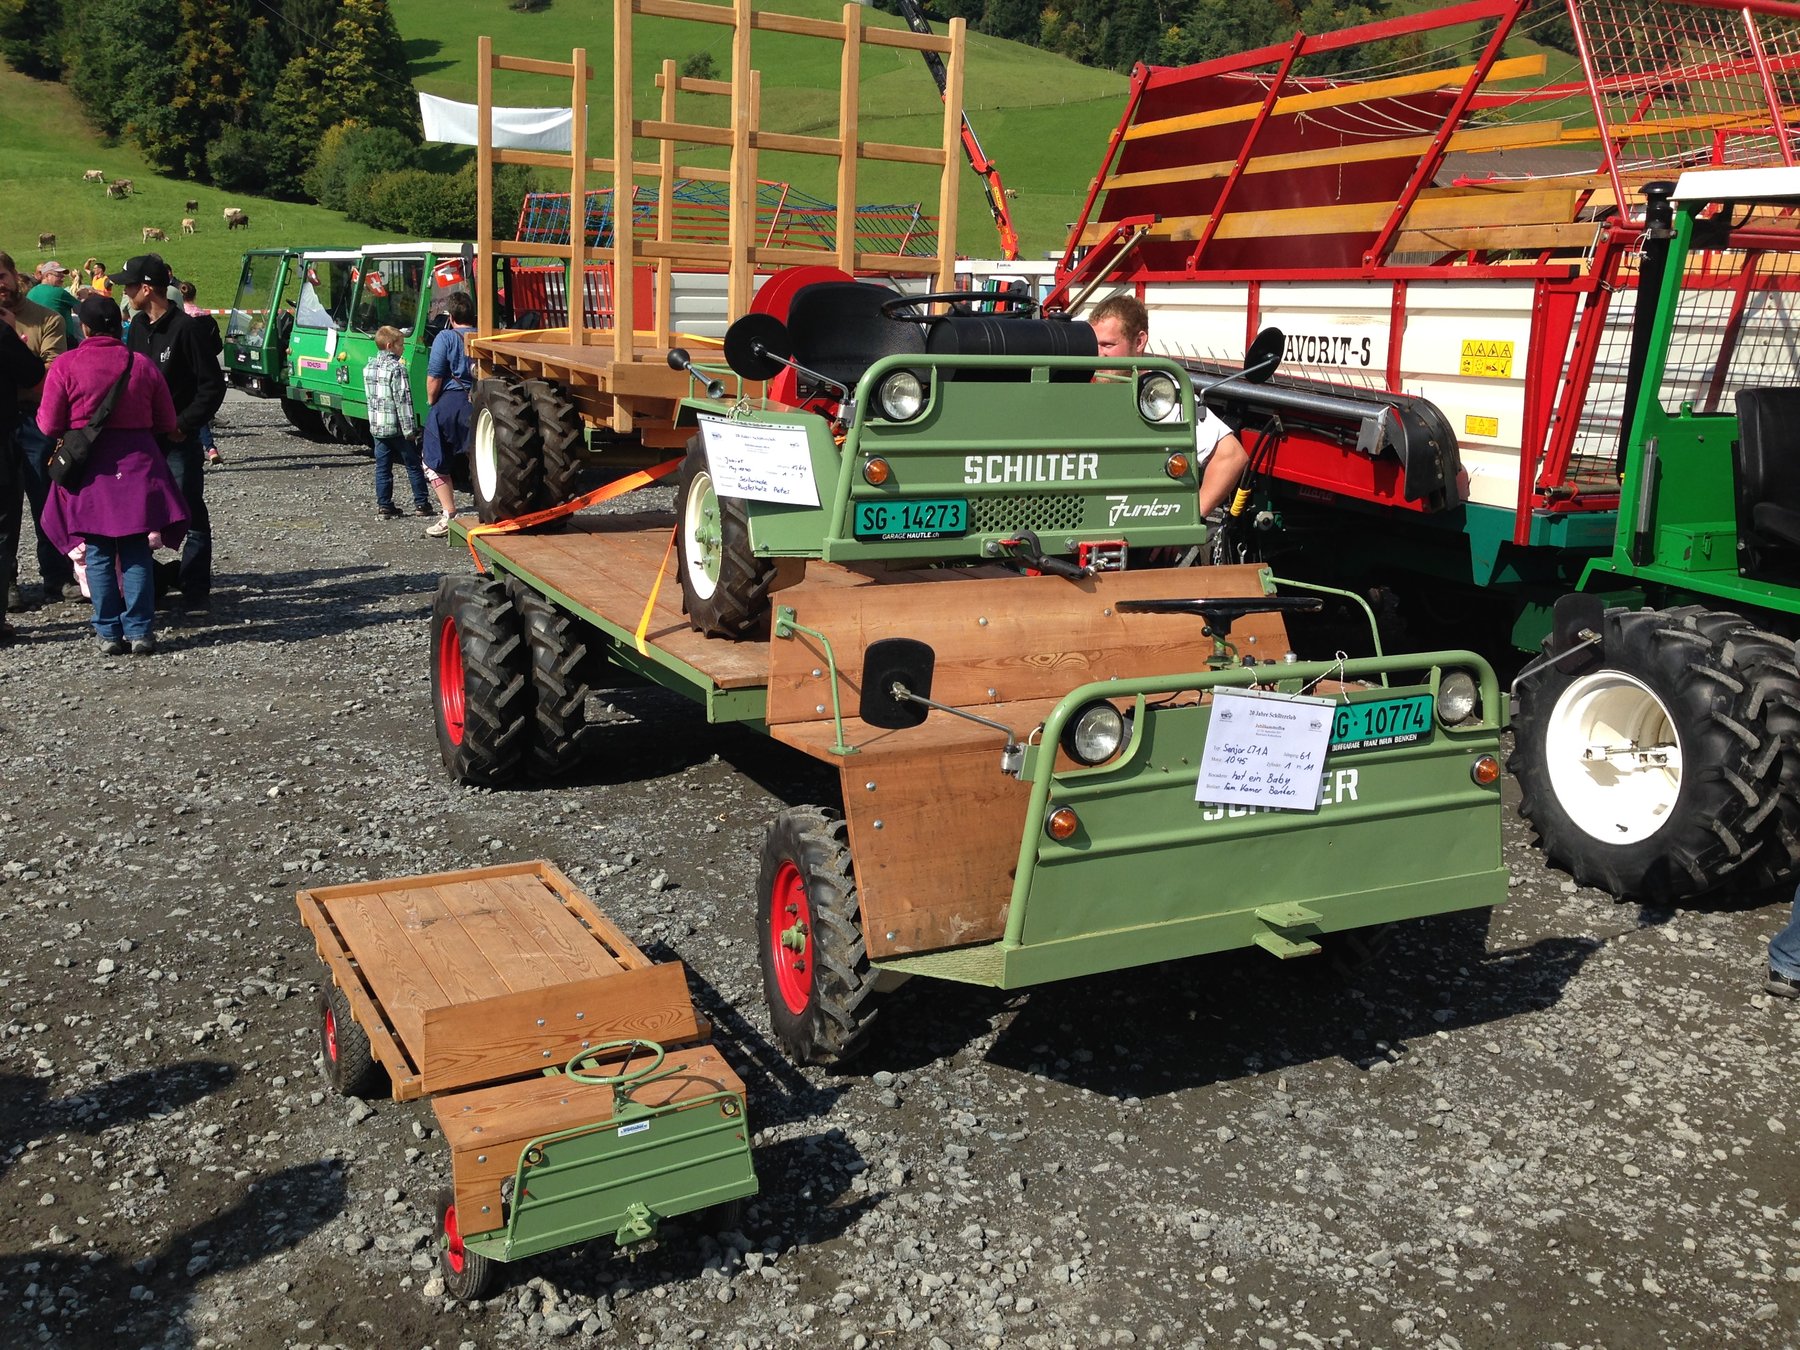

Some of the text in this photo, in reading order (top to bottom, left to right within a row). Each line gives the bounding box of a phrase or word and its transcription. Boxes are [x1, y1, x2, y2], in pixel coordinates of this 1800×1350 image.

[1283, 335, 1371, 366] AVORIT-S
[964, 453, 1099, 484] SCHILTER
[1106, 495, 1181, 527] Junior
[1364, 702, 1425, 736] 10774
[1394, 734, 1418, 743] BENKEN
[1300, 752, 1311, 760] 61
[1232, 770, 1247, 780] hat
[1249, 772, 1262, 782] ein
[1267, 773, 1291, 789] Baby
